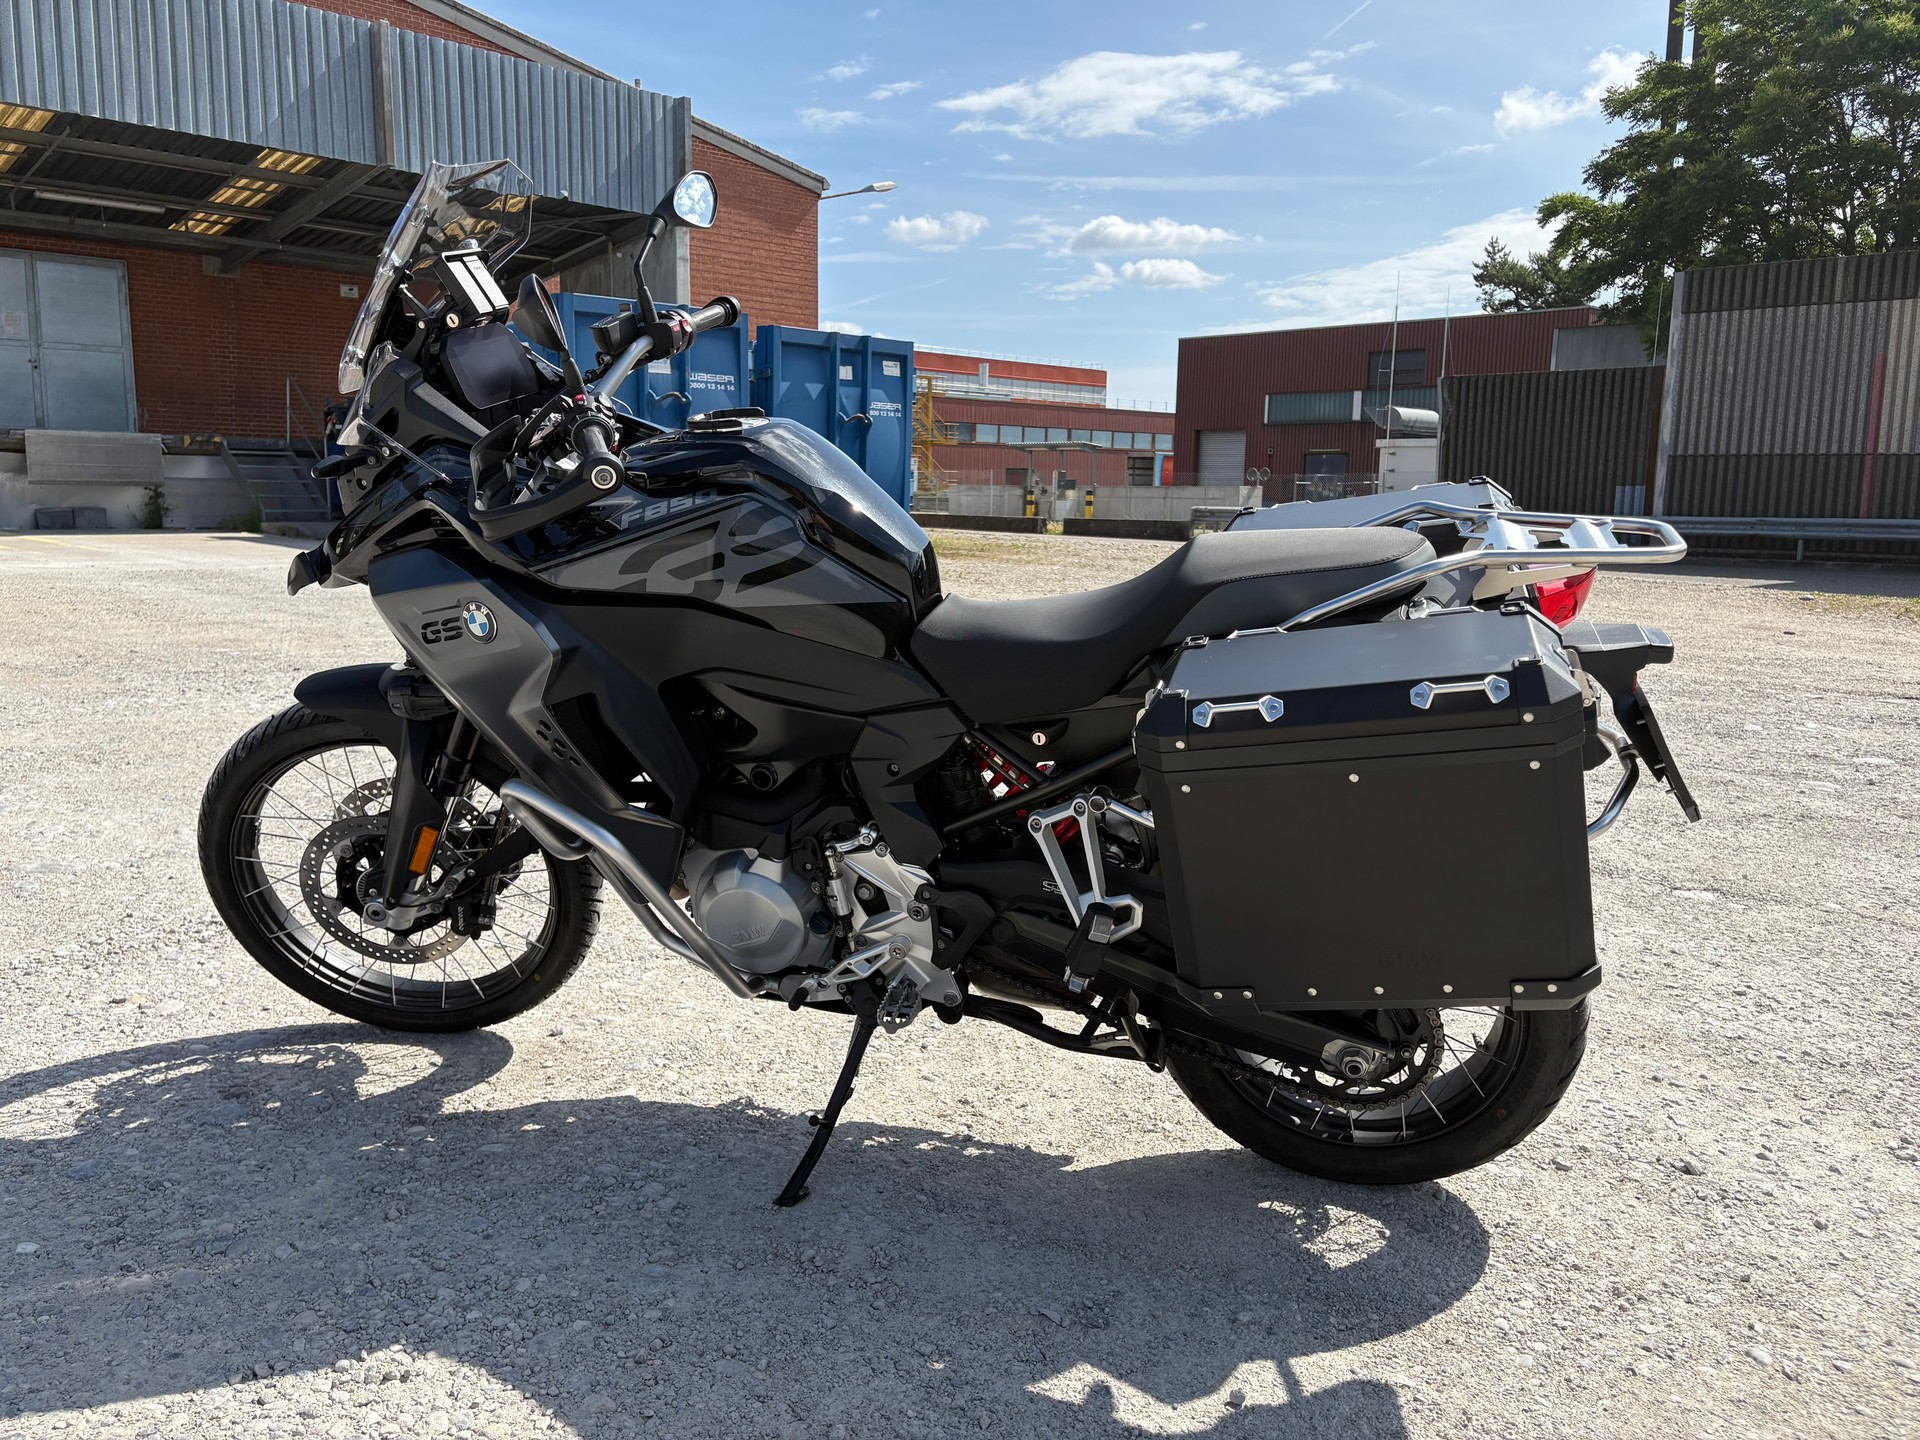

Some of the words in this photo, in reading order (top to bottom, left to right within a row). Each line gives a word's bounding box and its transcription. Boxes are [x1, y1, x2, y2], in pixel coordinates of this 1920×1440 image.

[620, 486, 718, 530] F850
[421, 616, 463, 644] GS
[730, 925, 767, 944] BMW
